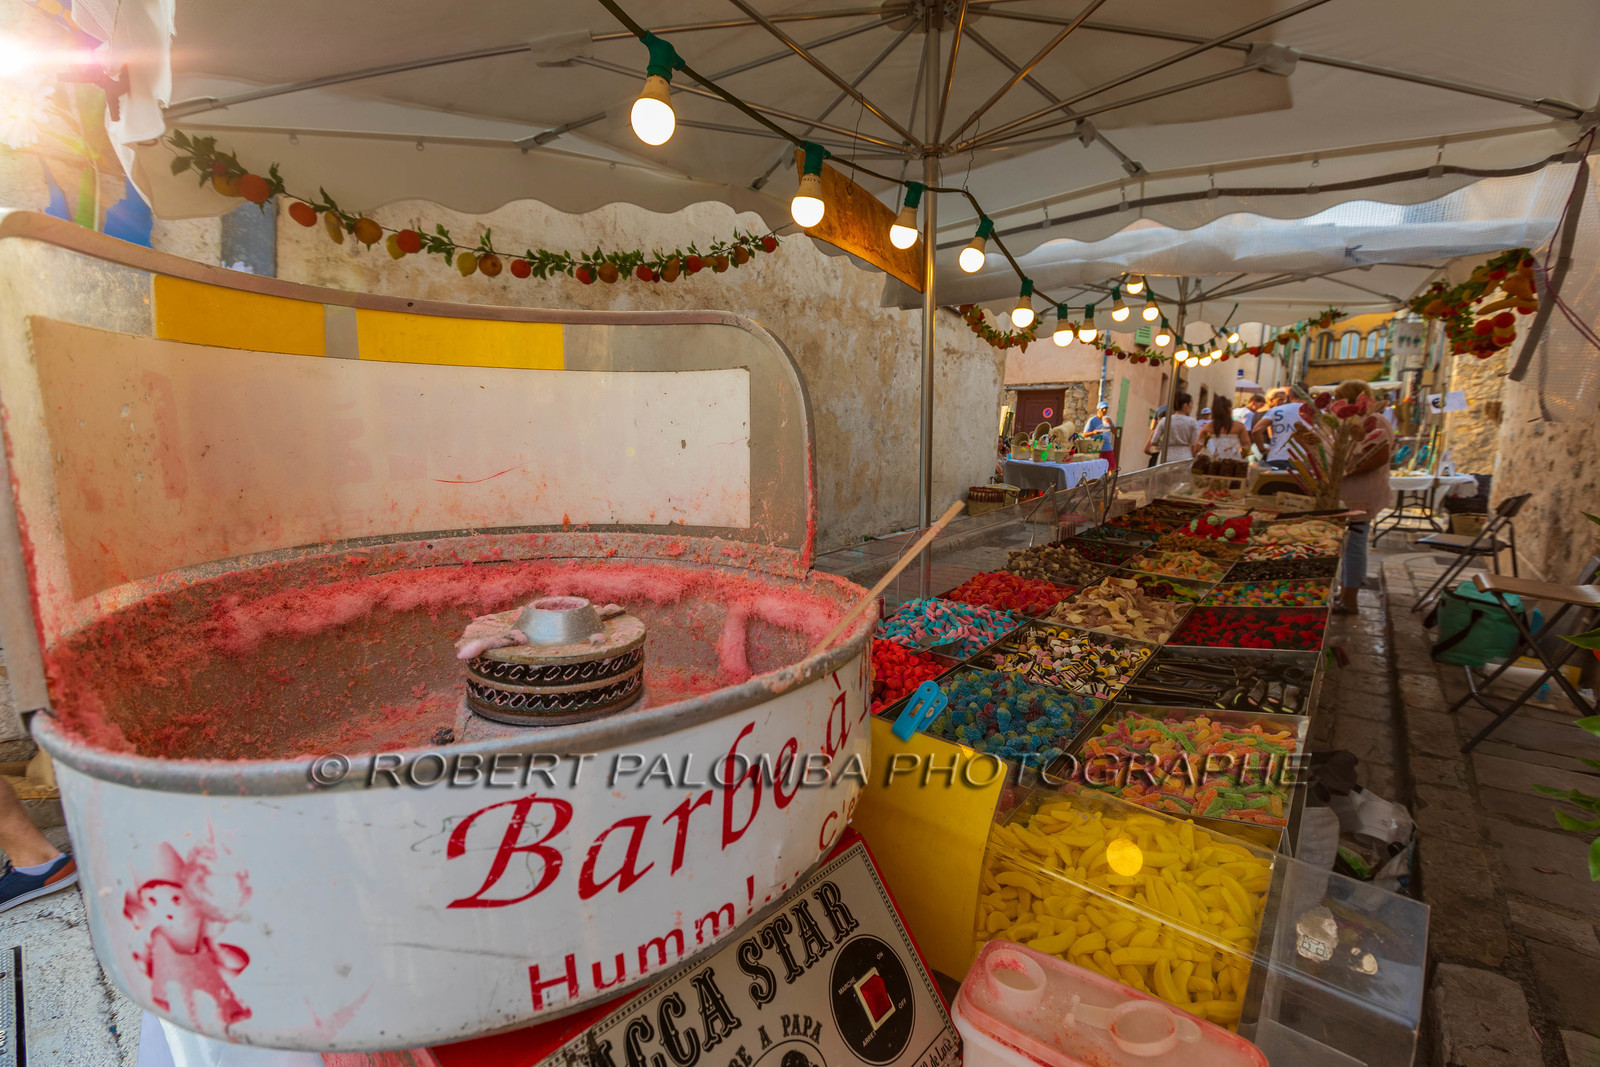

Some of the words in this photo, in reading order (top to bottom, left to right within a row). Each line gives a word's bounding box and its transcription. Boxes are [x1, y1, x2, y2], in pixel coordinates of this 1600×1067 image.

[446, 721, 797, 909] Barbe
[821, 671, 852, 761] à
[737, 880, 859, 1009] STAR
[876, 951, 884, 960] ON
[838, 976, 857, 995] MARCHE
[897, 997, 908, 1009] OFF
[757, 1024, 773, 1050] A
[780, 1013, 823, 1044] PAPA
[862, 1031, 877, 1048] ARRET
